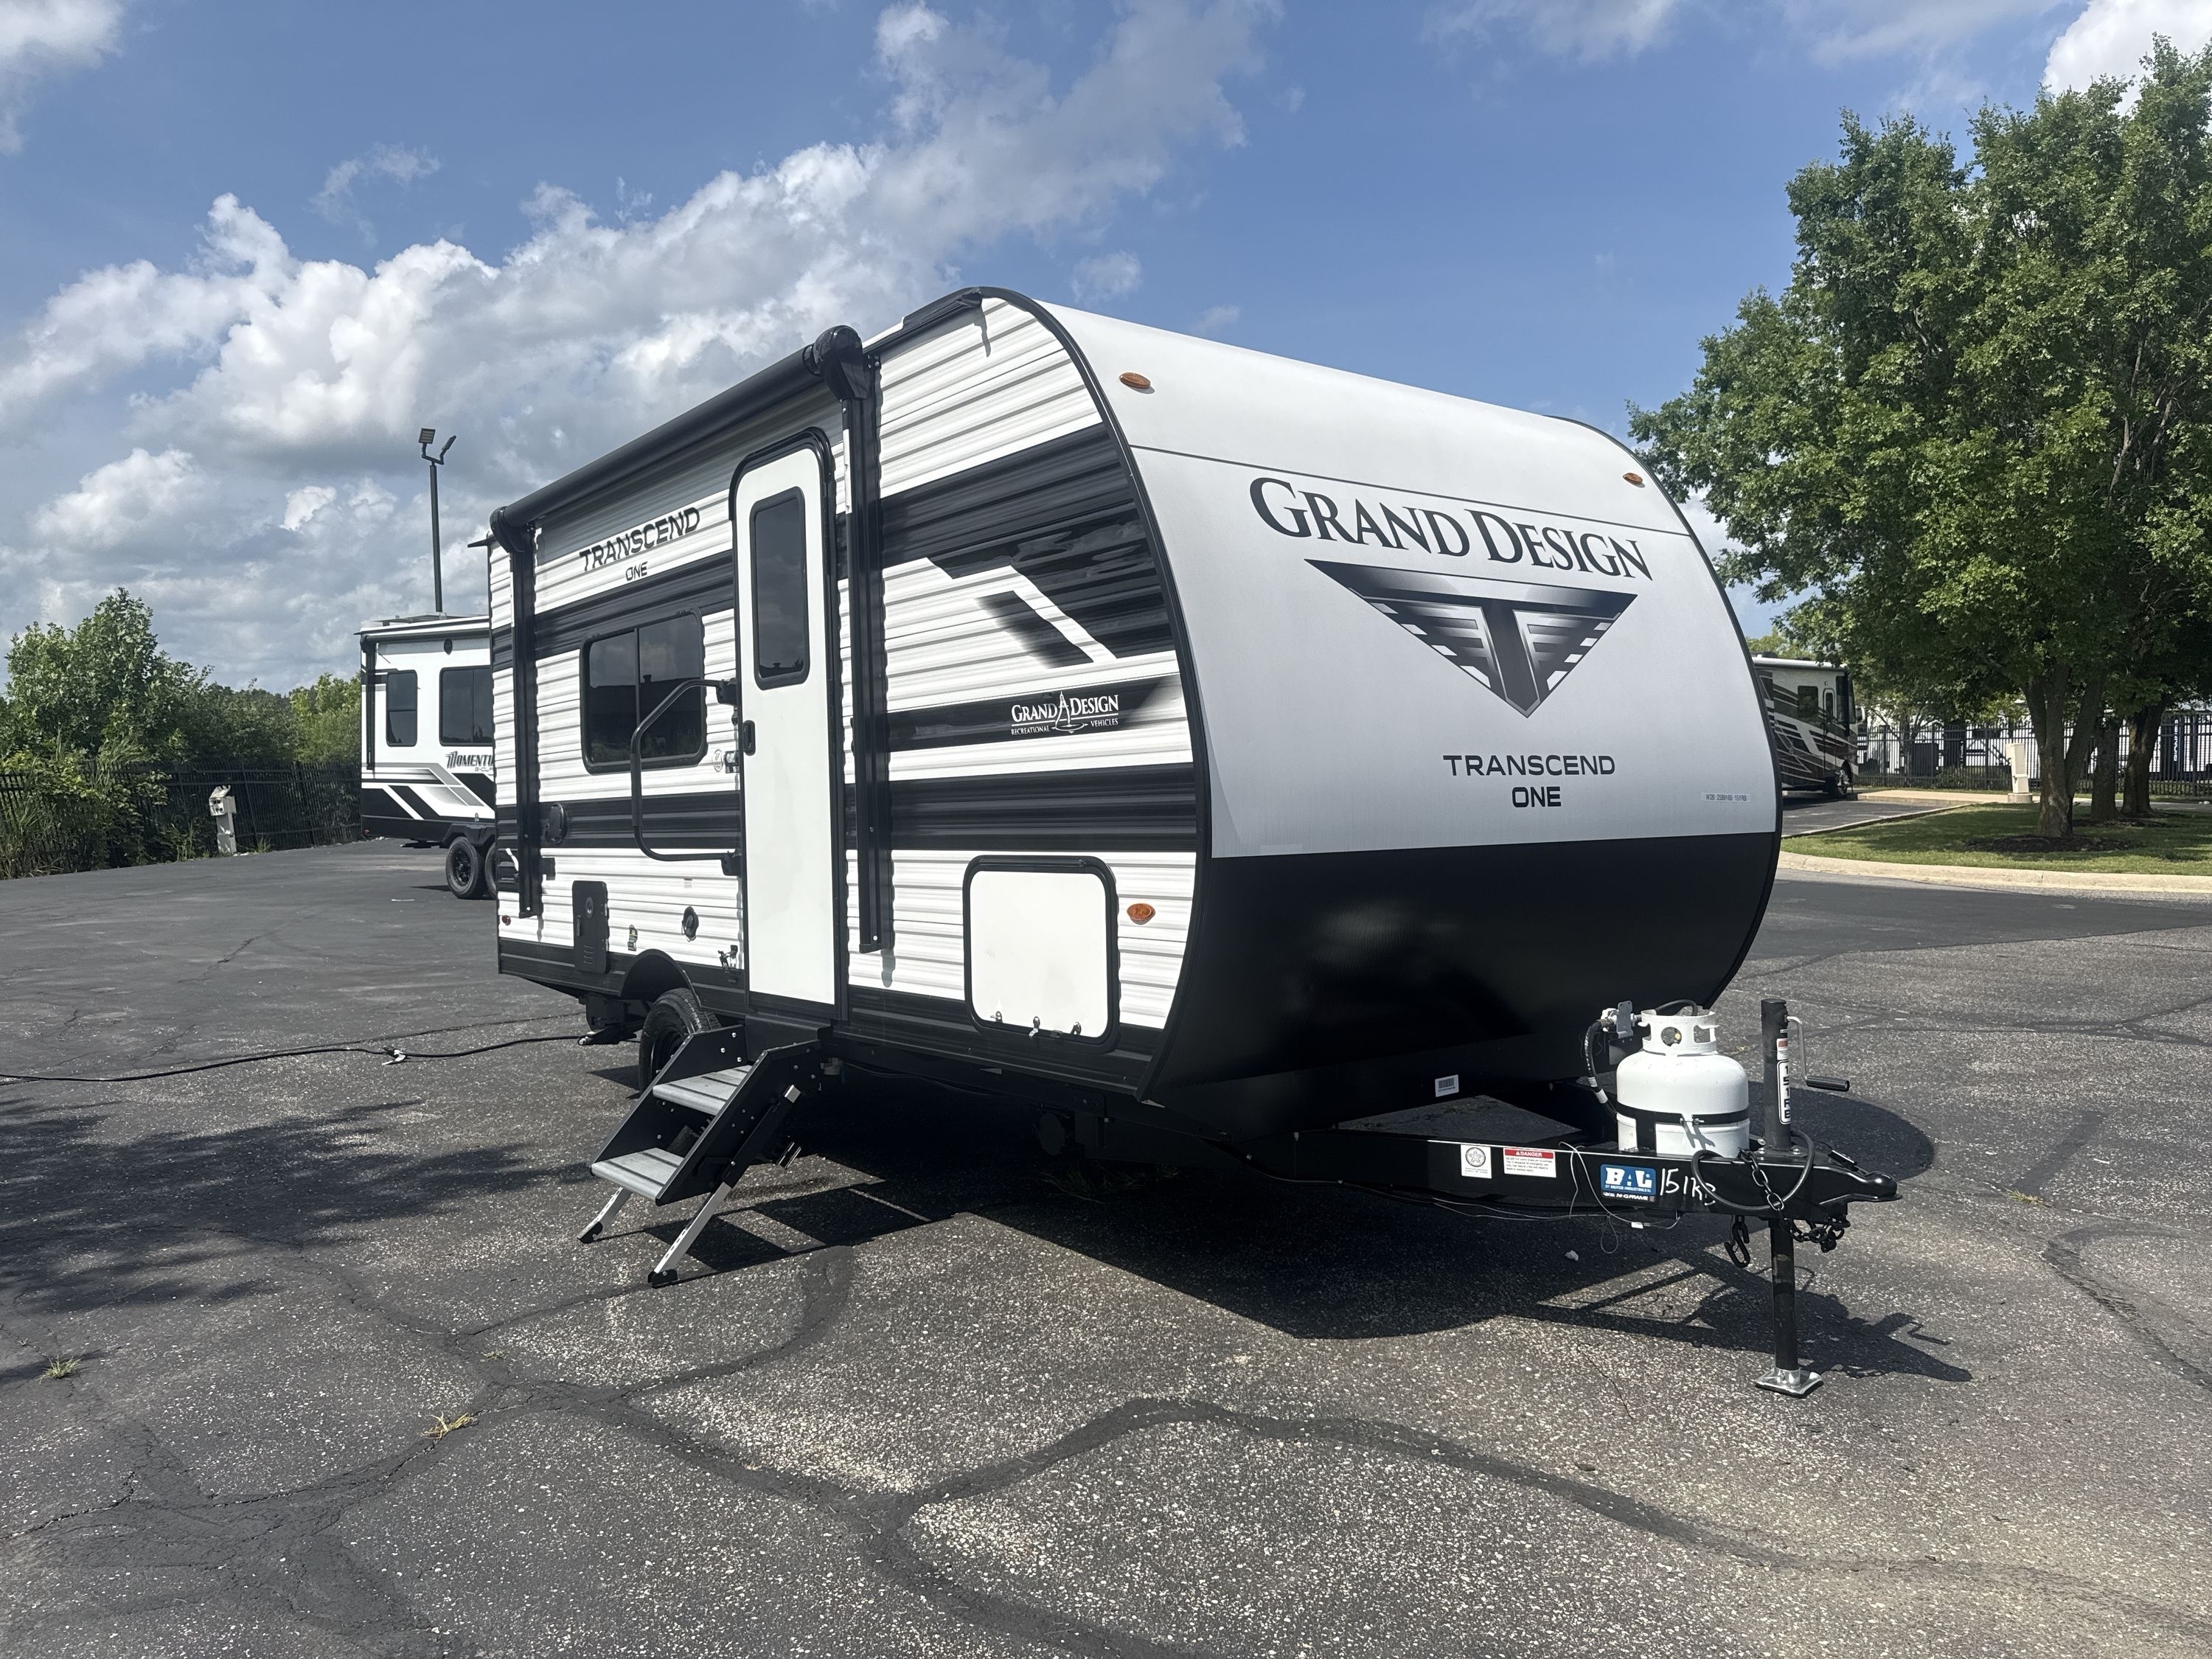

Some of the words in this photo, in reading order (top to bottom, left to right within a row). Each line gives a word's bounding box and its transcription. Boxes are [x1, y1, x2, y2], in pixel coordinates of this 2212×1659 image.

[579, 507, 700, 571] TRANSCEND
[1250, 477, 1470, 557] GRAND
[1464, 509, 1653, 581] DESIGN
[625, 561, 648, 581] ONE
[1012, 703, 1058, 723] GRAND
[1069, 695, 1119, 716] DESIGN
[1011, 726, 1050, 736] RECREATIONAL
[1091, 718, 1119, 728] VEHICLES
[445, 751, 493, 769] MOMENTU
[1443, 755, 1615, 776] TRANSCEND
[1512, 787, 1562, 807] ONE
[1605, 1167, 1652, 1189] BAL
